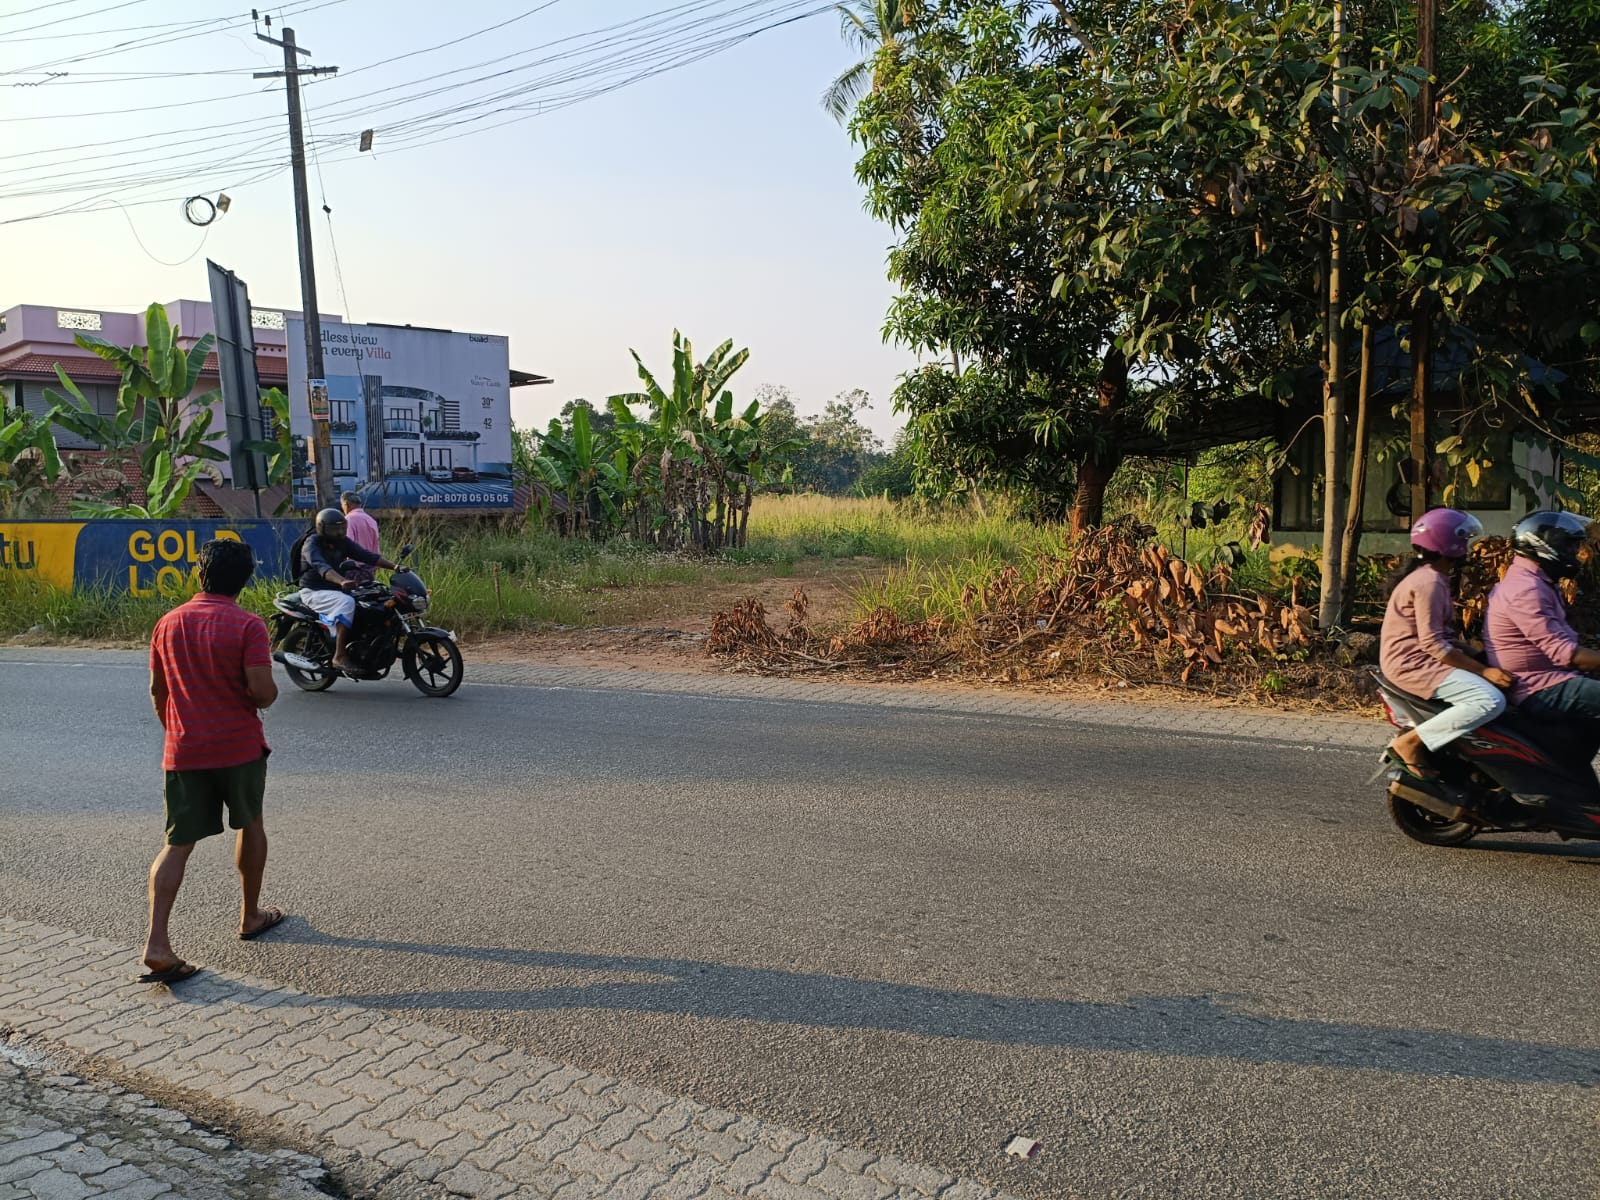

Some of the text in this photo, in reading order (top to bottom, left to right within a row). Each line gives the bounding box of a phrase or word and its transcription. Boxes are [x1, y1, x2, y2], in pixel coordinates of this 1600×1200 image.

[351, 333, 378, 345] view
[331, 346, 363, 360] every
[366, 346, 391, 360] Villa
[419, 493, 509, 503] Call: 8078 05 05 05
